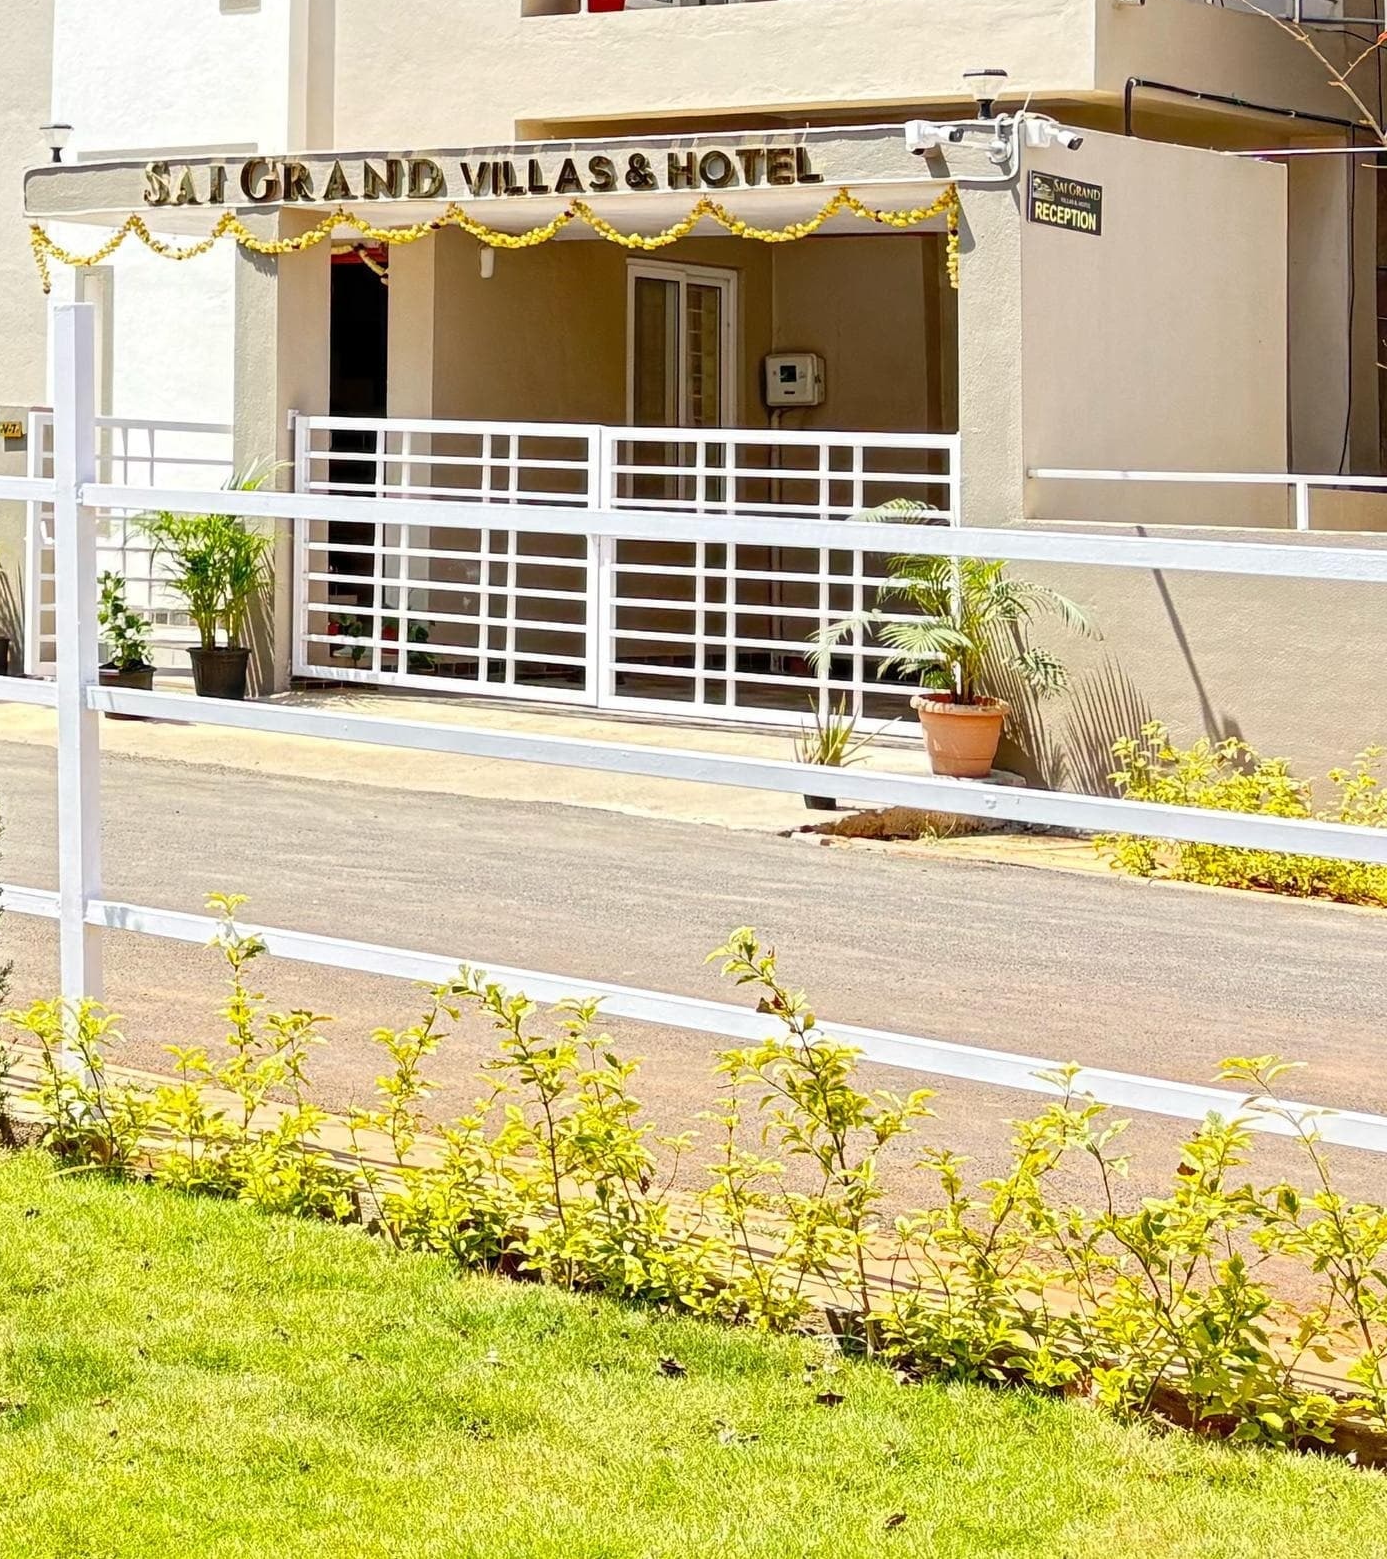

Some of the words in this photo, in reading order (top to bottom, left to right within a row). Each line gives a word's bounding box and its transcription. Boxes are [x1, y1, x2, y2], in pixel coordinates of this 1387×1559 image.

[143, 159, 227, 206] SAI
[239, 155, 445, 203] GRAND
[459, 154, 615, 198] VILLAS
[624, 152, 655, 189] &
[666, 146, 825, 191] HOTEL
[1069, 182, 1100, 201] GRAND
[1034, 201, 1096, 231] RECEPTION
